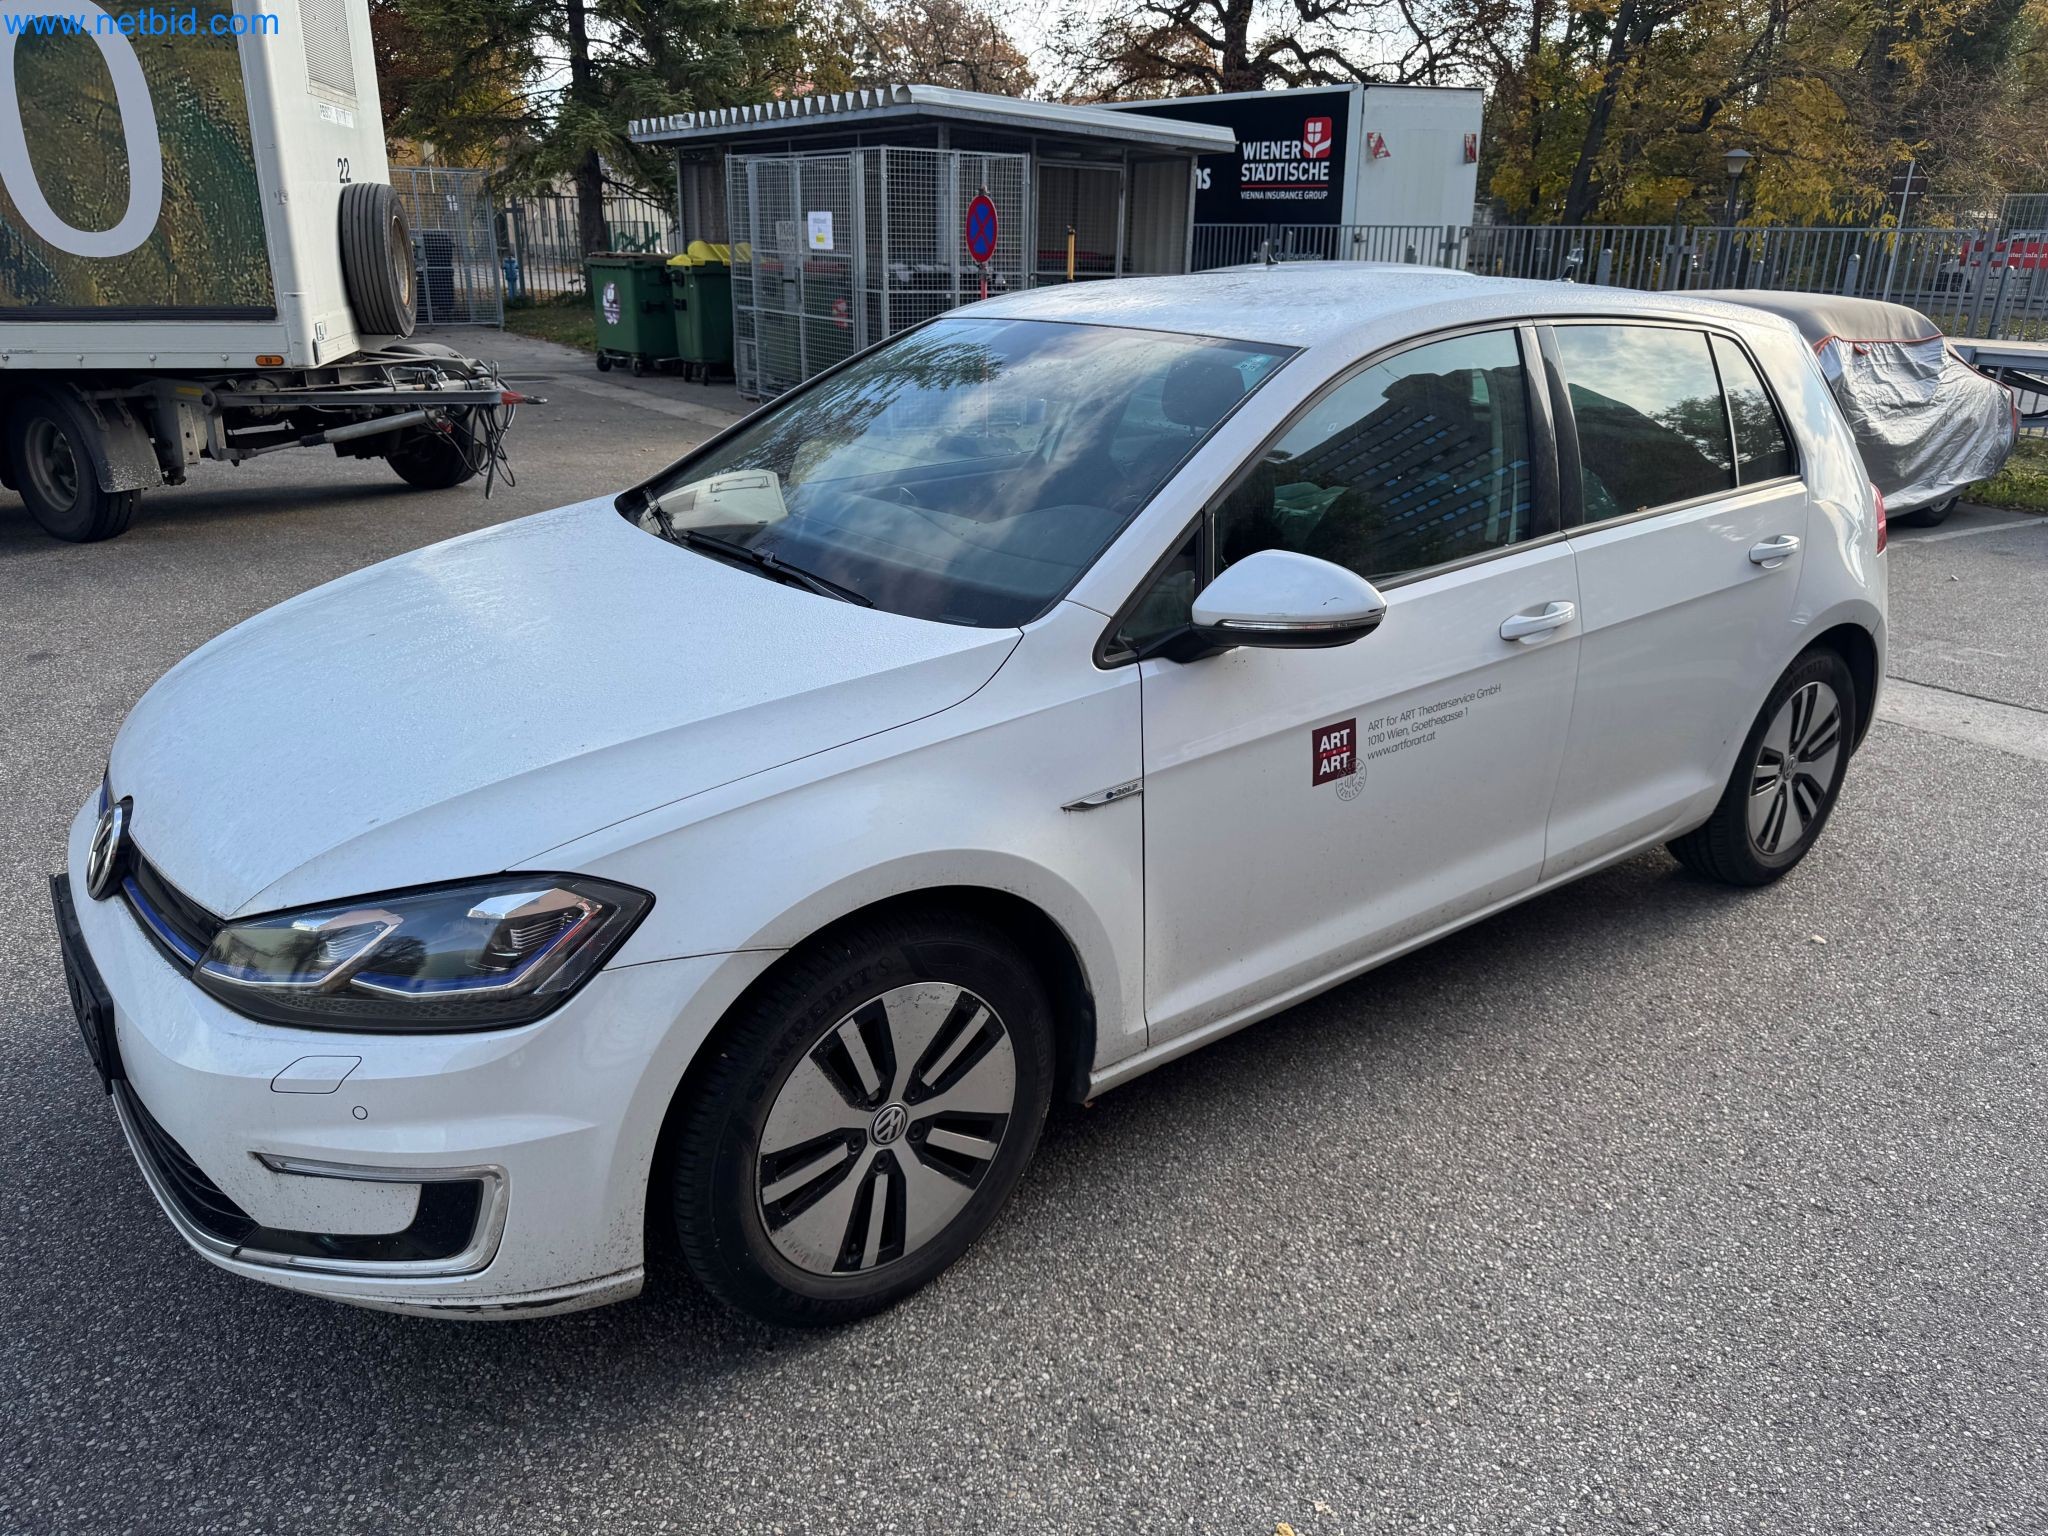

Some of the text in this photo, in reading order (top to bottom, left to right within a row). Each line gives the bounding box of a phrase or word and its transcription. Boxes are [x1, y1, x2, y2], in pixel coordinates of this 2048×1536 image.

[1242, 140, 1302, 161] WIENER
[337, 157, 352, 183] 22
[1241, 161, 1330, 182] STÄDTISCHE
[1240, 190, 1329, 200] VIENNA INSURANCE GROUP
[1368, 683, 1502, 732] ART for ART Theaterservice GmbH
[1367, 732, 1386, 746] 1010
[1387, 726, 1409, 740] Wien,
[1411, 709, 1464, 733] Goethegasse
[1319, 728, 1351, 753] ART
[1367, 731, 1437, 760] www.artforart.at
[1319, 751, 1351, 776] ART
